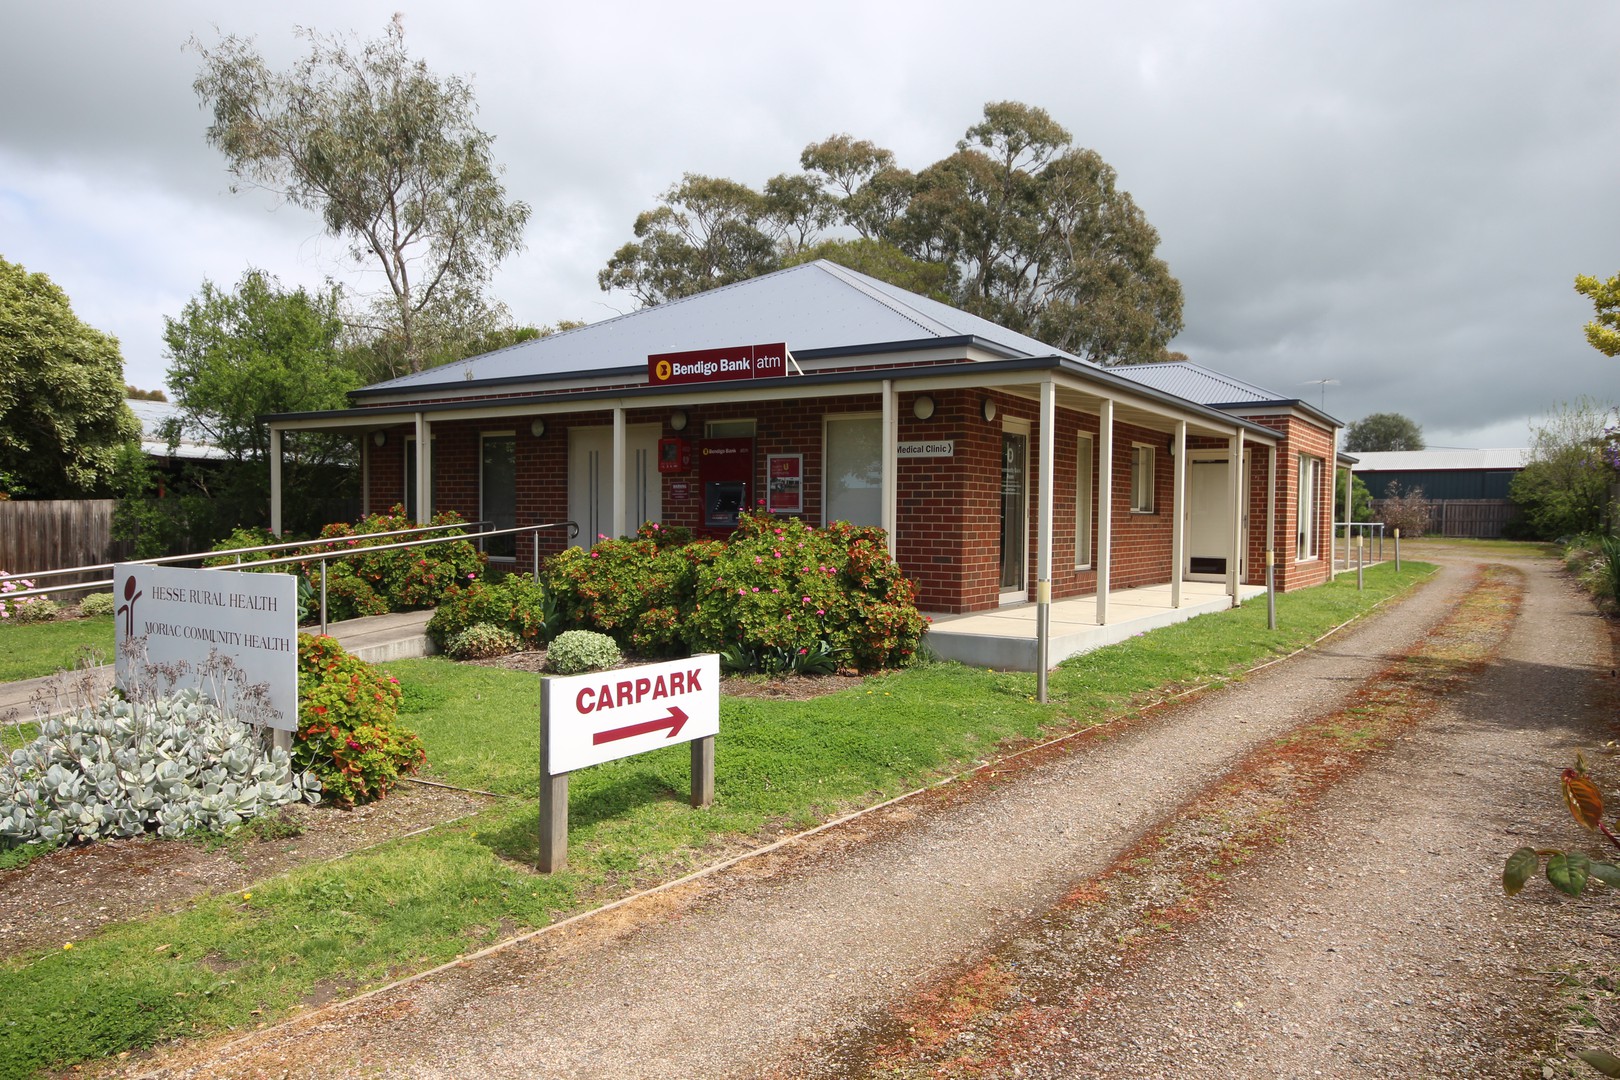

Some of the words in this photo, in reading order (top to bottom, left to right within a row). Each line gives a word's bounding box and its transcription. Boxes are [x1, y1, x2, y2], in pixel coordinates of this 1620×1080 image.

[672, 361, 718, 376] Bendigo
[720, 357, 751, 372] Bank
[756, 355, 781, 369] atm
[709, 447, 726, 455] Bendigo
[926, 444, 947, 453] Clinic
[152, 586, 187, 602] HESSE
[189, 589, 226, 607] RURAL
[229, 593, 278, 612] HEALTH
[145, 621, 181, 637] MORIAC
[183, 625, 242, 646] COMMUNITY
[244, 634, 290, 652] HEALTH
[575, 668, 703, 715] CARPARK
